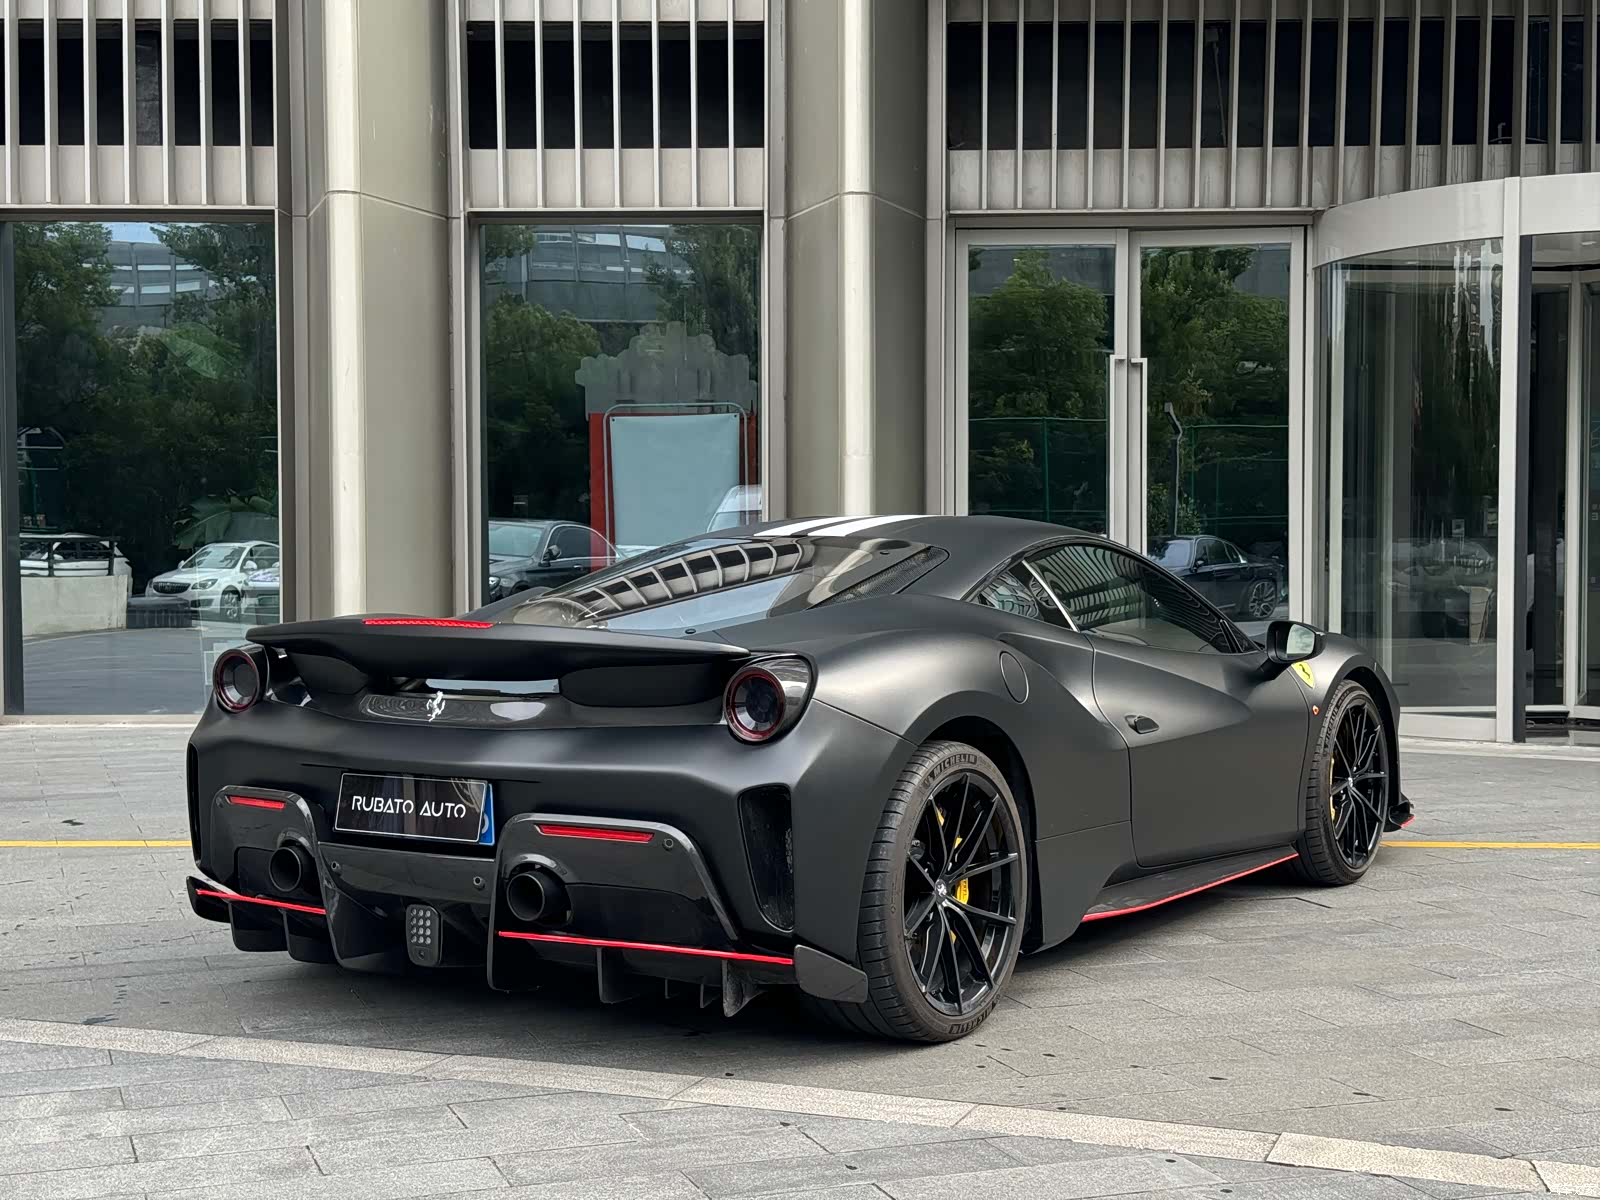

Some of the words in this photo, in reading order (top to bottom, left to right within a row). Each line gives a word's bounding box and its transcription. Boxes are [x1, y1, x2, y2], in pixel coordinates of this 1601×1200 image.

[933, 753, 977, 777] MICHELIN
[351, 795, 414, 814] RUBATO
[419, 800, 467, 818] AUTO
